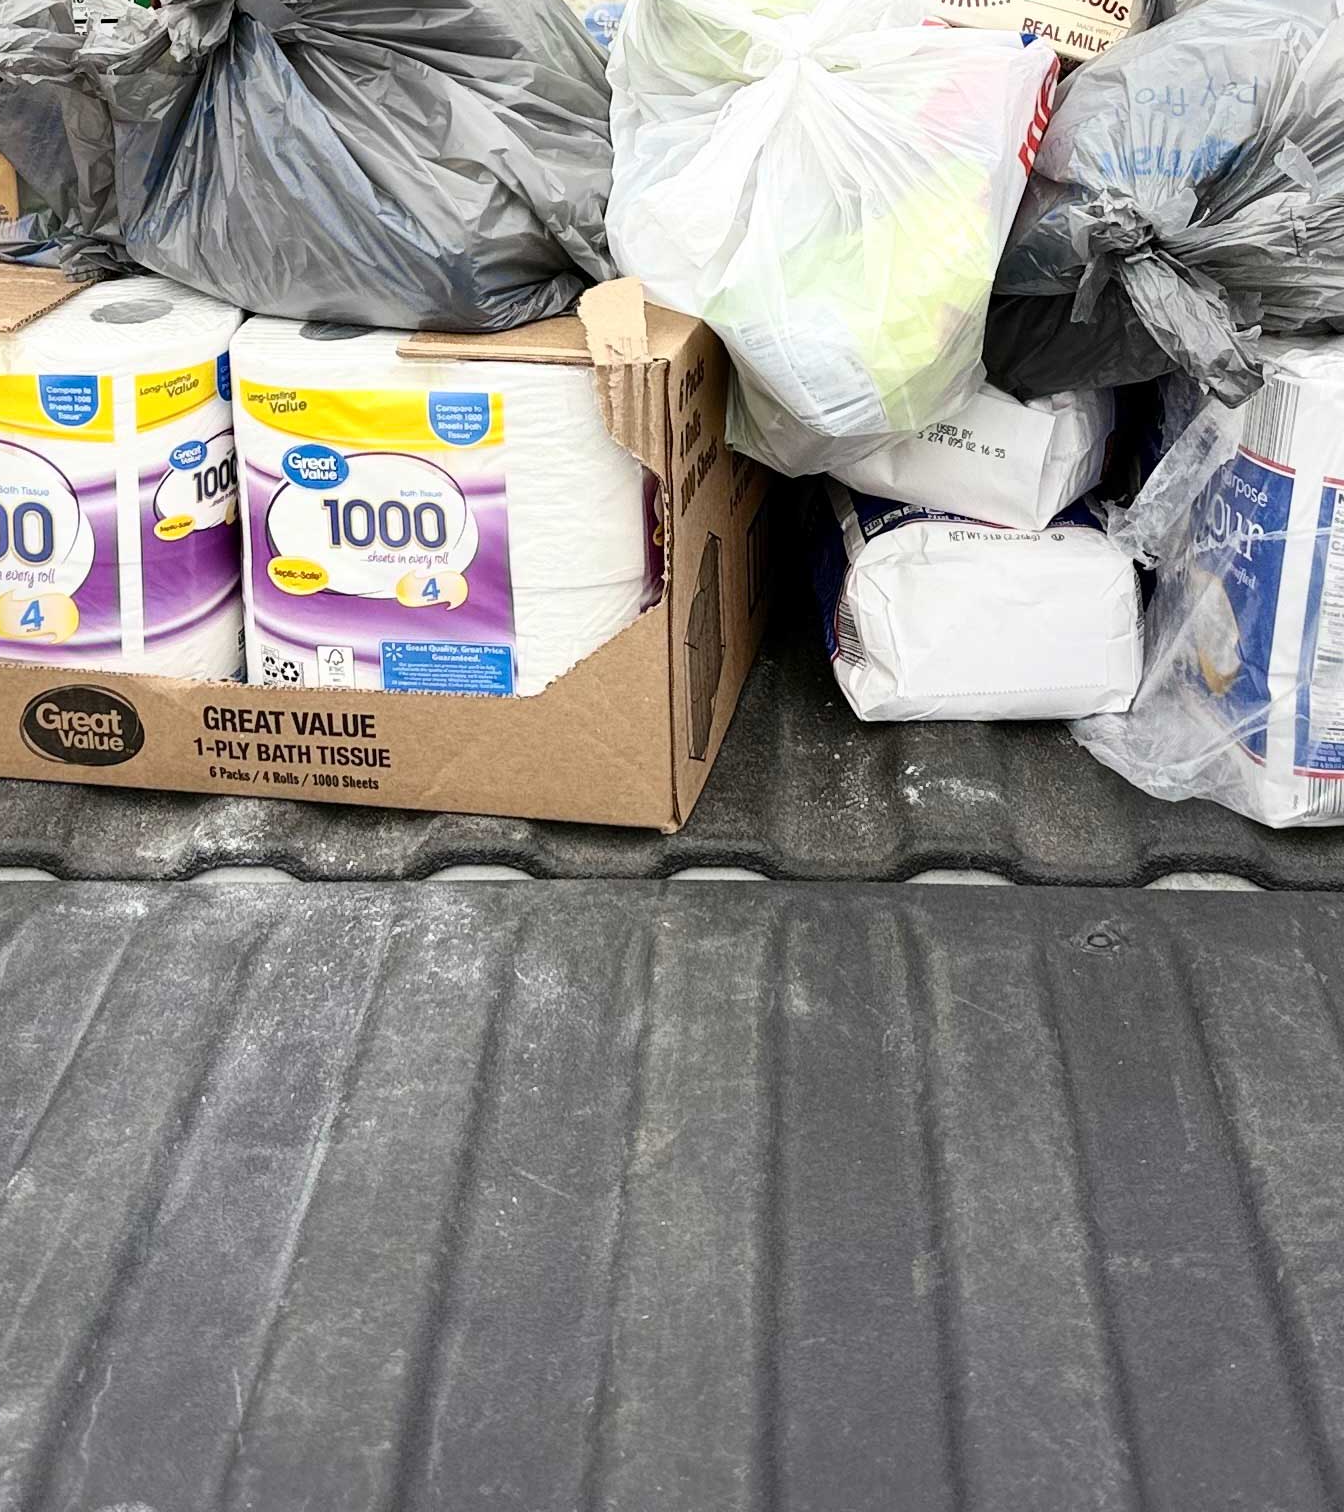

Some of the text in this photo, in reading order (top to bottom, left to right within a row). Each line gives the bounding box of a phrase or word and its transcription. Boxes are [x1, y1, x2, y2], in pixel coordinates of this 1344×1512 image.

[1021, 17, 1062, 42] REAL
[139, 374, 192, 395] Long-Lasting
[167, 379, 199, 398] Value
[269, 398, 307, 415] Value
[435, 404, 472, 414] Compare
[438, 422, 482, 431] Sheets Bath
[464, 413, 482, 422] 1000
[936, 423, 973, 439] USED BY
[173, 445, 203, 460] Great
[287, 453, 336, 470] Great
[299, 467, 338, 482] Value
[20, 486, 50, 496] Tissue
[322, 498, 447, 550] 1000
[397, 551, 449, 569] in every roll
[5, 568, 35, 586] every
[37, 566, 56, 583] roll
[422, 578, 441, 600] 4
[20, 600, 45, 628] 4
[406, 644, 427, 653] Great
[460, 646, 483, 655] Great
[431, 653, 481, 662] Guaranteed.
[35, 702, 122, 735] Great
[202, 705, 377, 739] GREAT VALUE
[59, 731, 124, 752] Value
[193, 737, 391, 769] 1-PLY BATH TISSUE
[209, 765, 379, 790] 6 Packs 4 Rolls 1000 Sheets
